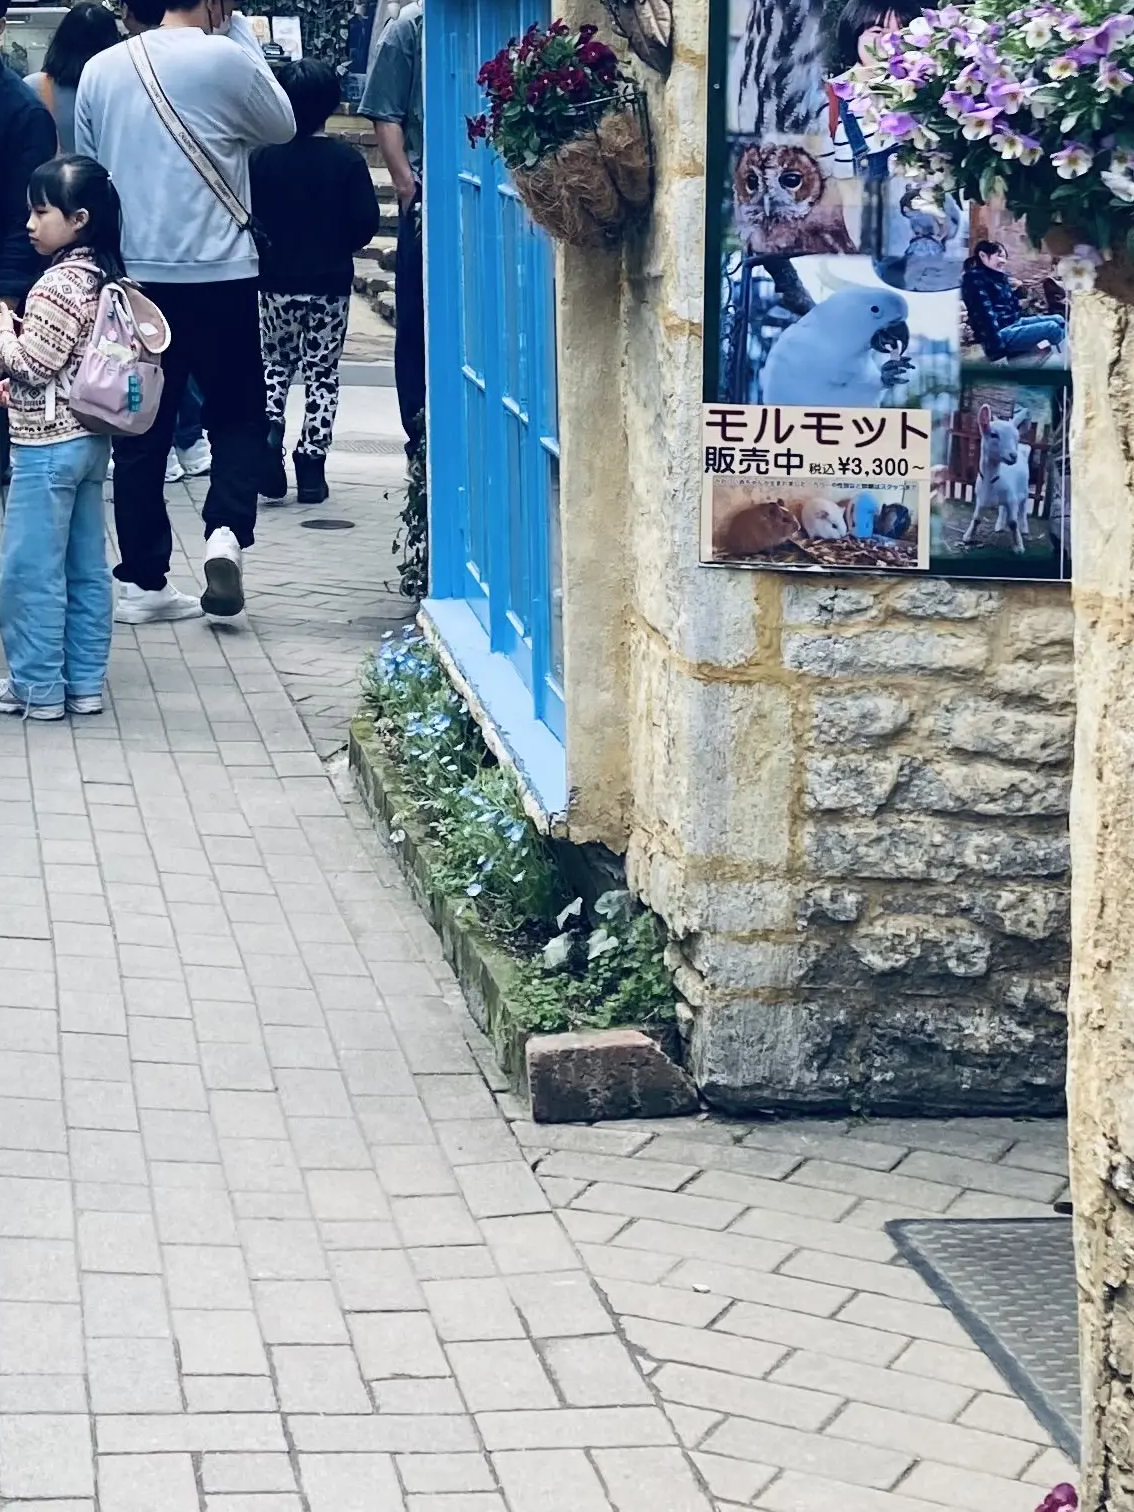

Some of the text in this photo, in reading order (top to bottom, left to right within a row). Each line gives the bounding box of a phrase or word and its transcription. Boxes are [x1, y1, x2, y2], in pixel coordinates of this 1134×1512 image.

[705, 407, 929, 450] モルモット
[704, 446, 804, 476] 販売中
